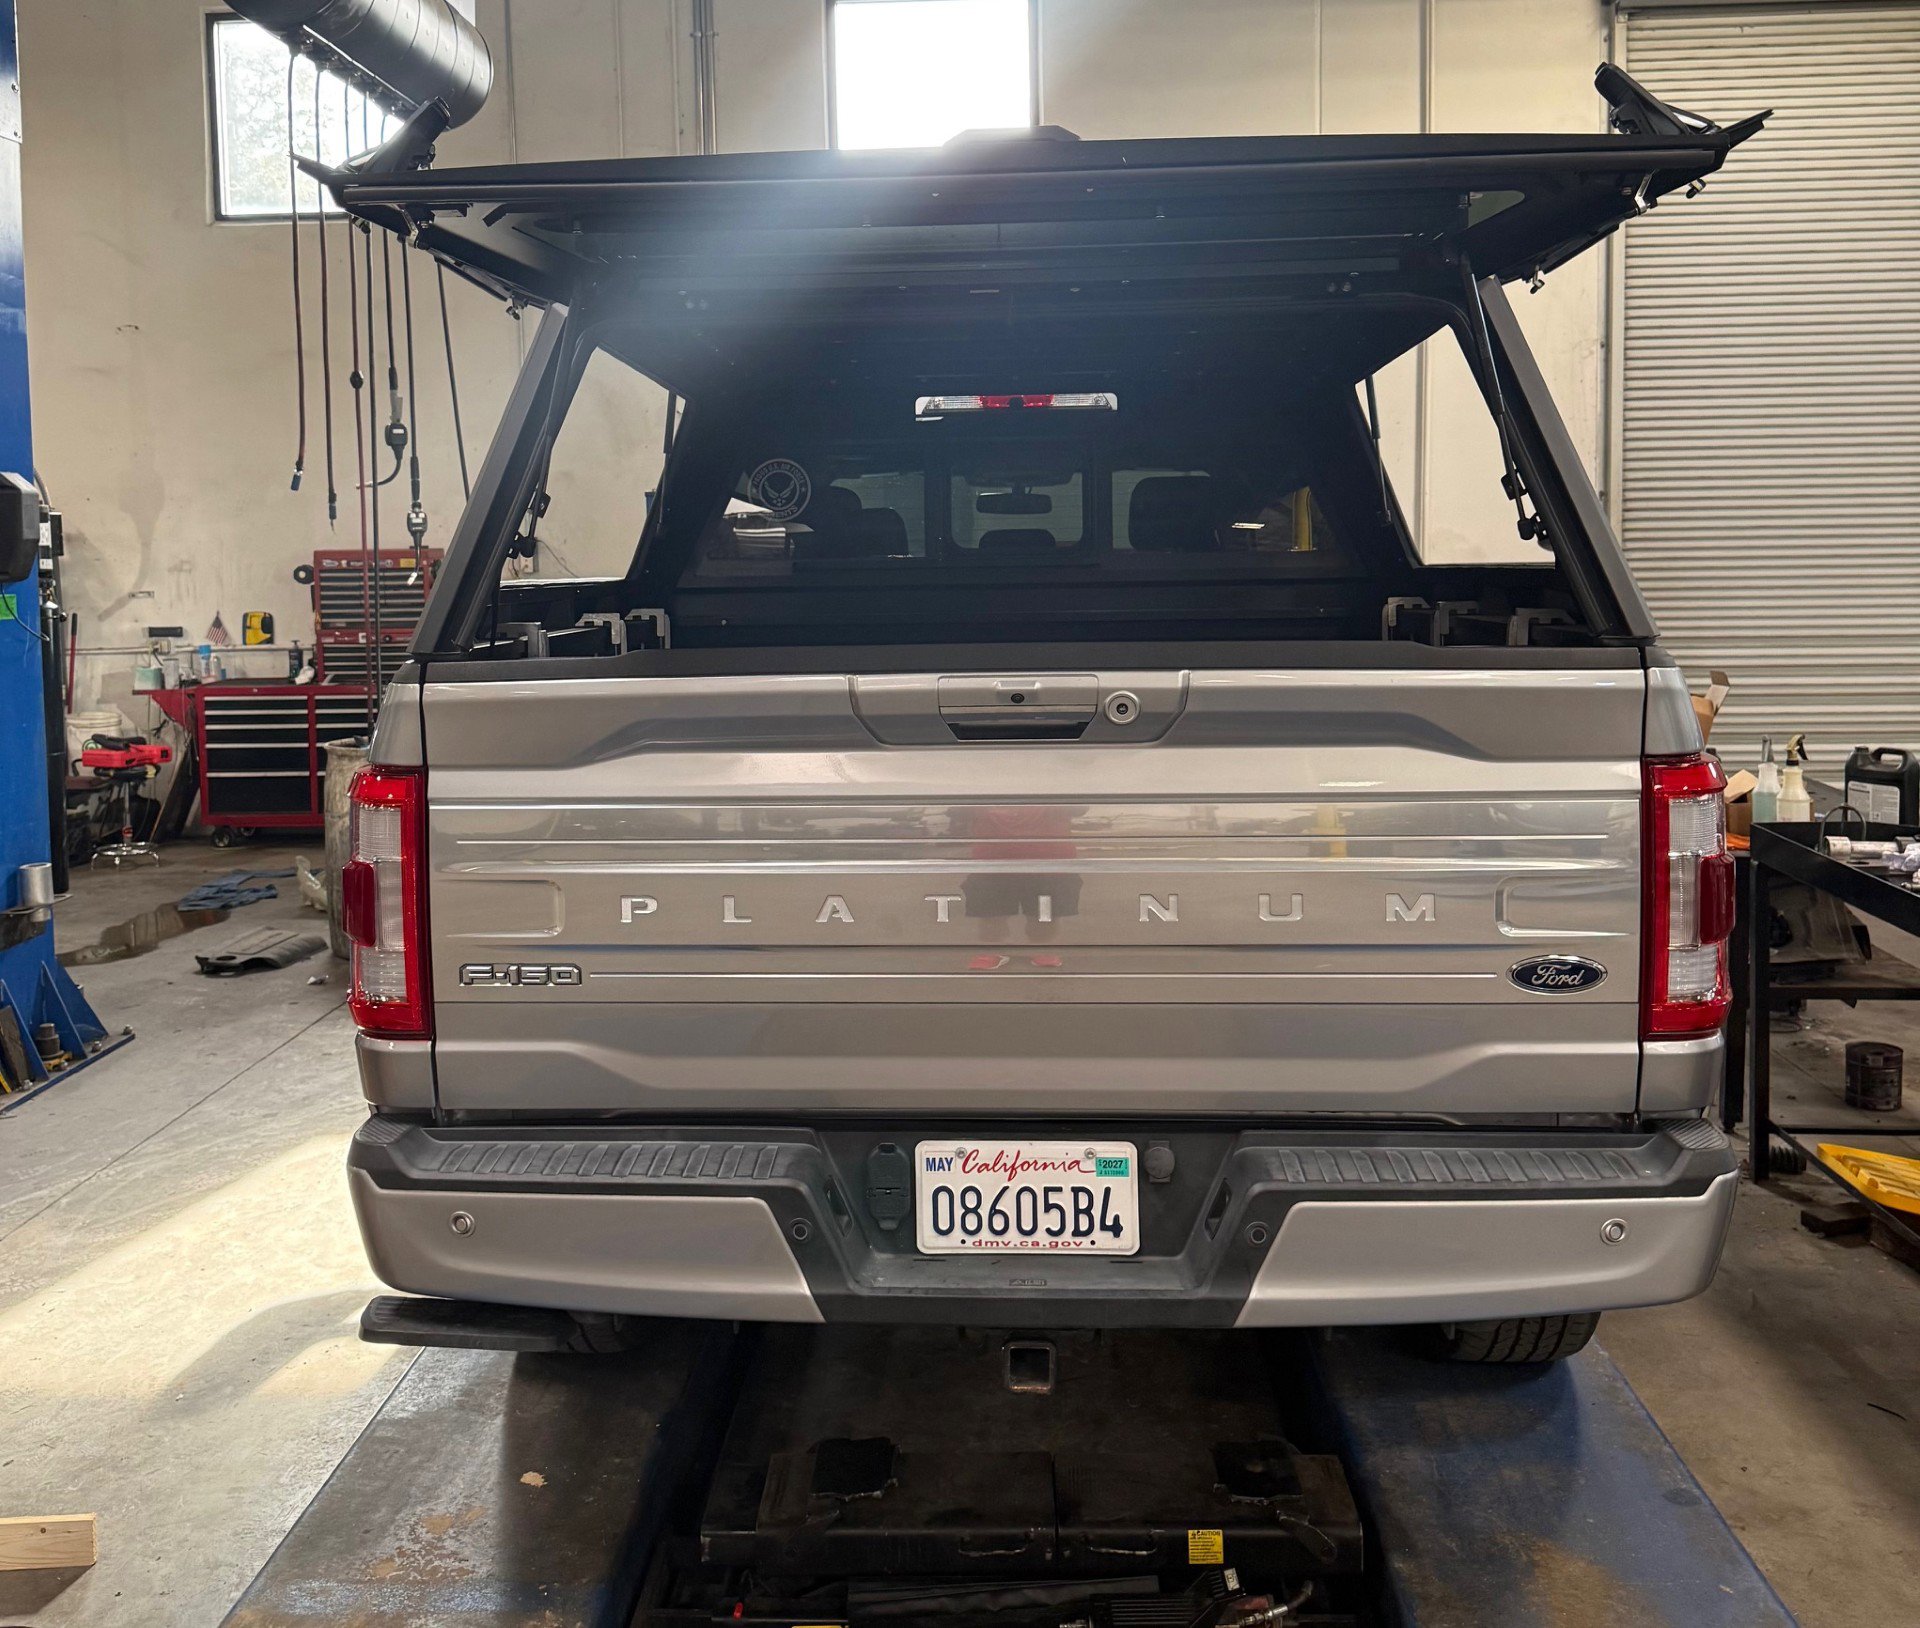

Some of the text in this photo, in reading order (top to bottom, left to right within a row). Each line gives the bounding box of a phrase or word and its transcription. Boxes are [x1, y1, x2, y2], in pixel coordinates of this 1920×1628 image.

[620, 893, 1435, 923] PLATINUM
[459, 963, 582, 985] F-150
[1531, 964, 1585, 986] Ford
[925, 1157, 953, 1172] MAY
[961, 1149, 1096, 1181] California
[1102, 1160, 1123, 1169] 2027
[932, 1185, 1124, 1238] 08605B4
[972, 1239, 1083, 1248] dmv.ca.gov
